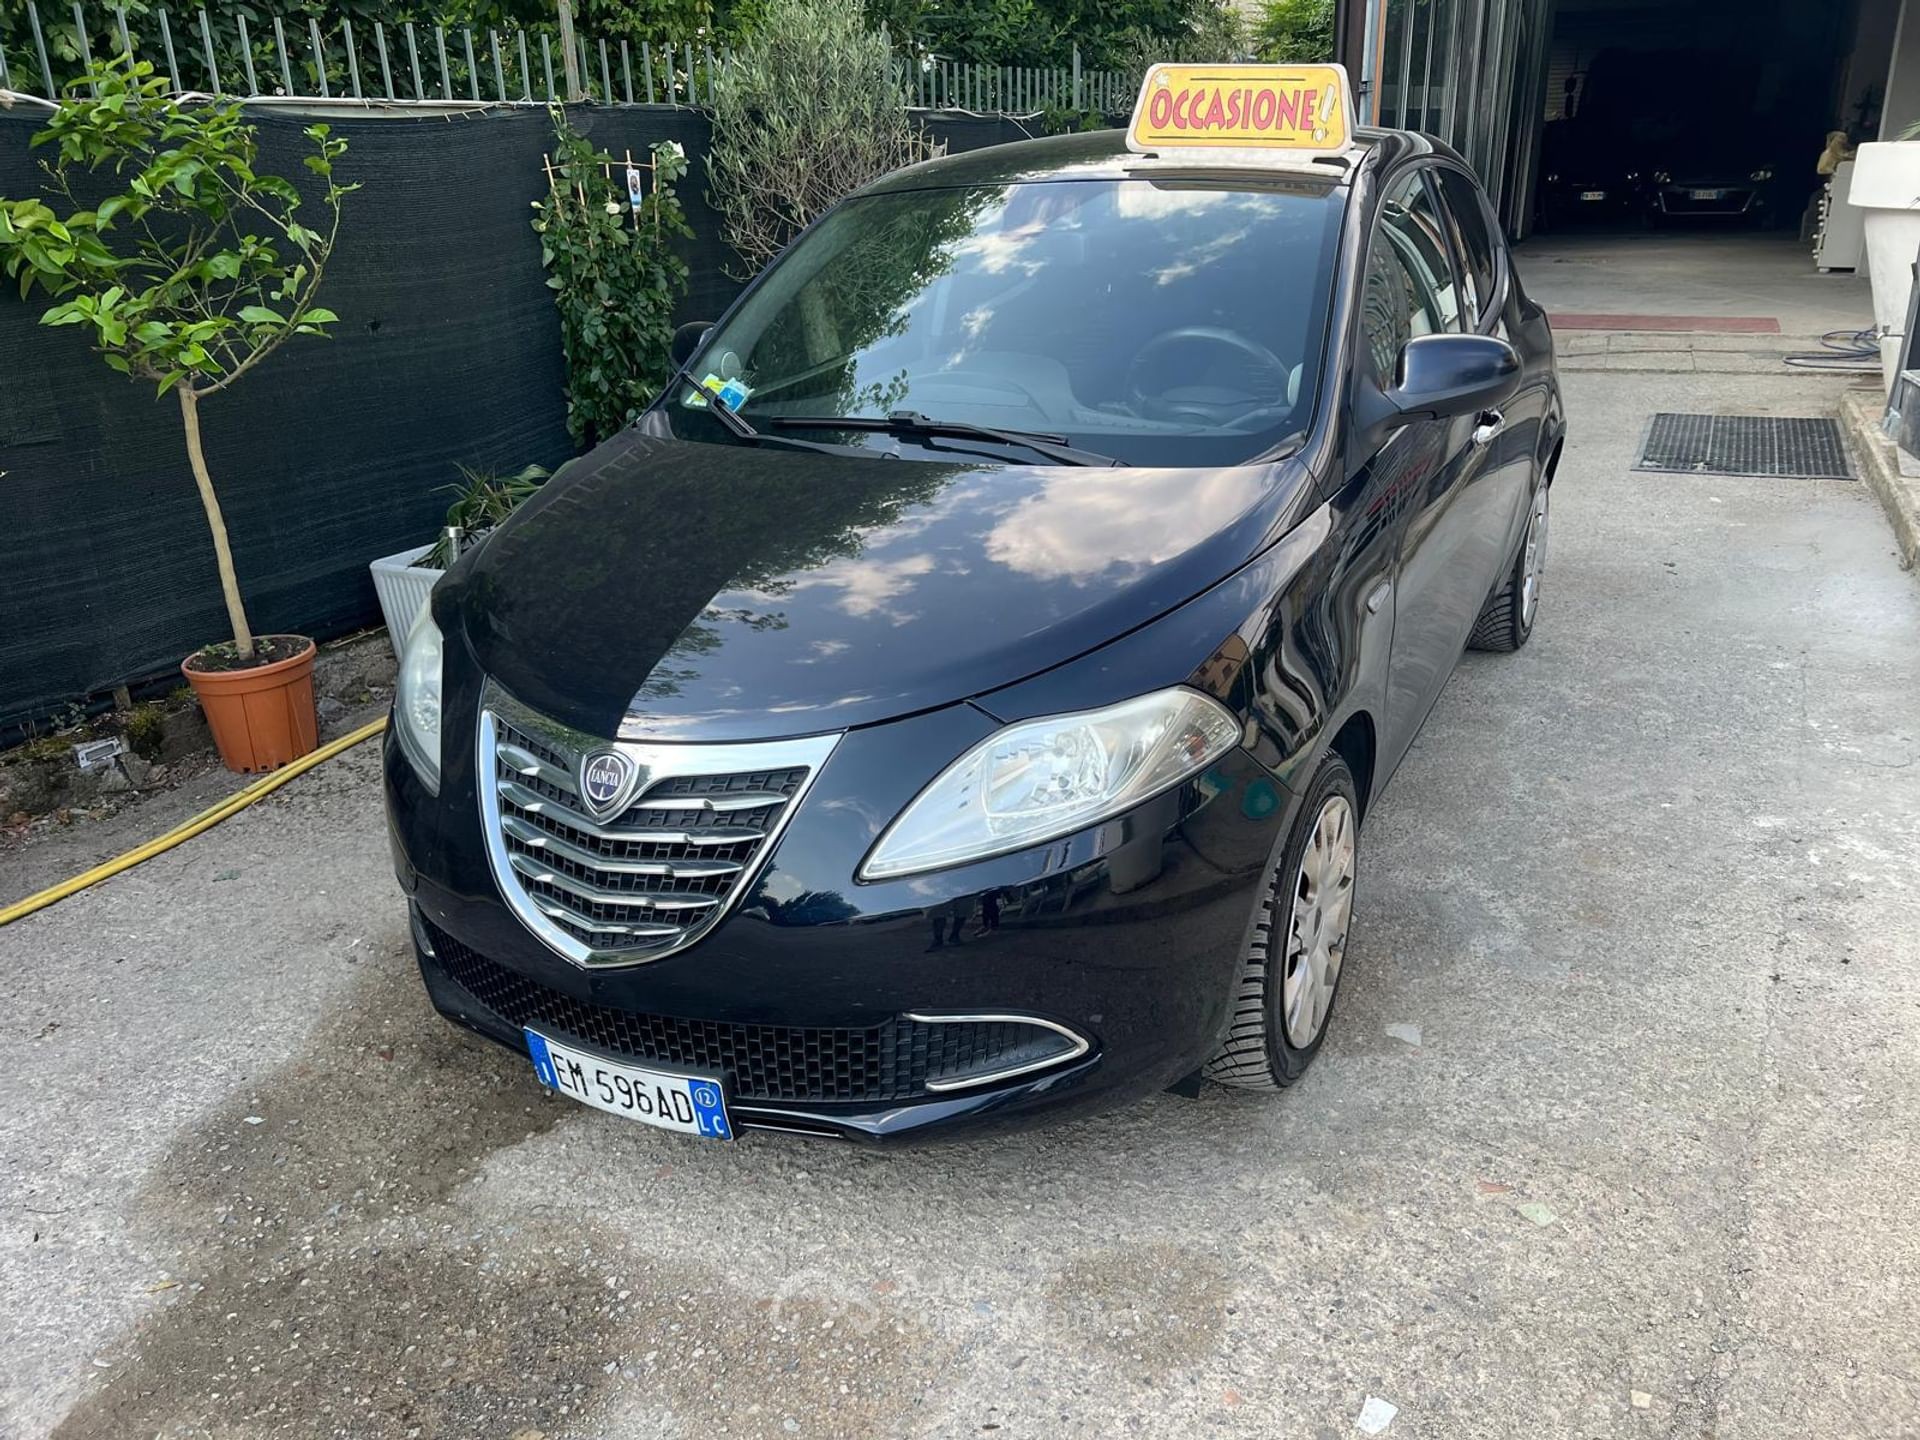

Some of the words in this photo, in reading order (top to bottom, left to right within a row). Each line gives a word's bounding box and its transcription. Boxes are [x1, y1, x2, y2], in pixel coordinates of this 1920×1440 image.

[591, 768, 618, 786] LANCIA
[551, 1052, 589, 1097] EM
[595, 1070, 694, 1124] 596AD
[698, 1111, 724, 1134] LC
